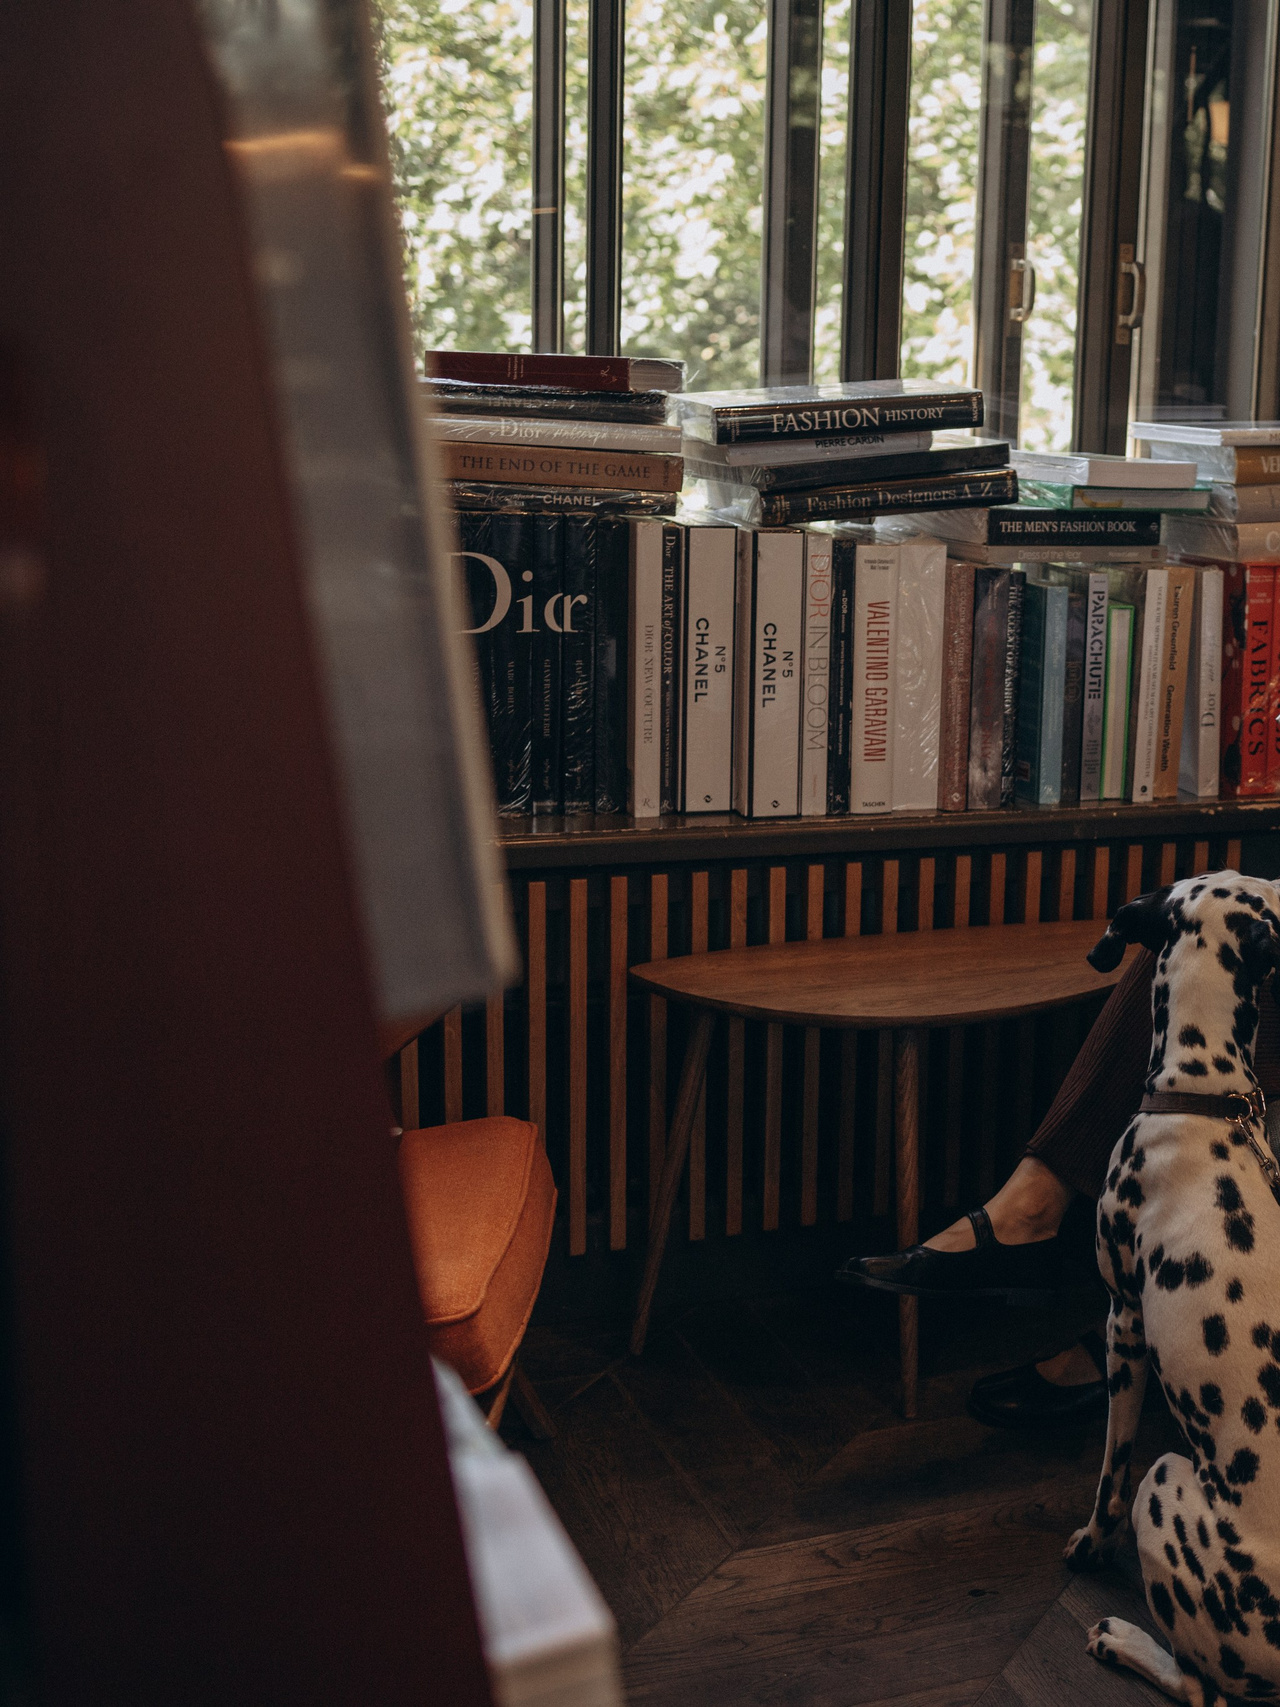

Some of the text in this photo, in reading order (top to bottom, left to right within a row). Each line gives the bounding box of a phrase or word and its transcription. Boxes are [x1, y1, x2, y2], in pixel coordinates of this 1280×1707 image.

[499, 418, 544, 438] Dior
[772, 406, 945, 433] FASHION HISTORY
[815, 435, 884, 449] PIERRE CARDIN
[459, 455, 651, 479] THE END OF THE GAME
[543, 494, 601, 506] CHANEL
[806, 494, 871, 512] Fashion
[877, 488, 957, 506] Designers
[961, 483, 973, 498] A
[980, 481, 993, 497] Z
[999, 520, 1137, 533] THE MEN'S FASHION BOOK
[664, 535, 677, 558] Dior
[450, 551, 588, 634] Dior
[663, 566, 674, 591] THE
[663, 594, 674, 618] ART
[1007, 585, 1018, 608] THE
[644, 625, 654, 653] DIOR
[1006, 611, 1018, 650] ACCENT
[1088, 591, 1106, 699] PARACHUTE
[1168, 585, 1182, 671] Lauren Greenfield
[663, 632, 674, 674] COLOR
[694, 618, 709, 703] CHANEL
[762, 623, 777, 708] CHANEL
[807, 554, 831, 750] DIOR IN BLOOM
[863, 601, 890, 762] VALENTINO GARAVANI
[1004, 665, 1015, 714] FASHION
[1248, 620, 1269, 756] FABRICS
[643, 688, 653, 744] COUTURE
[1201, 693, 1216, 727] Dior
[1160, 685, 1175, 772] Generation Wealth
[862, 801, 886, 809] TASCHEN
